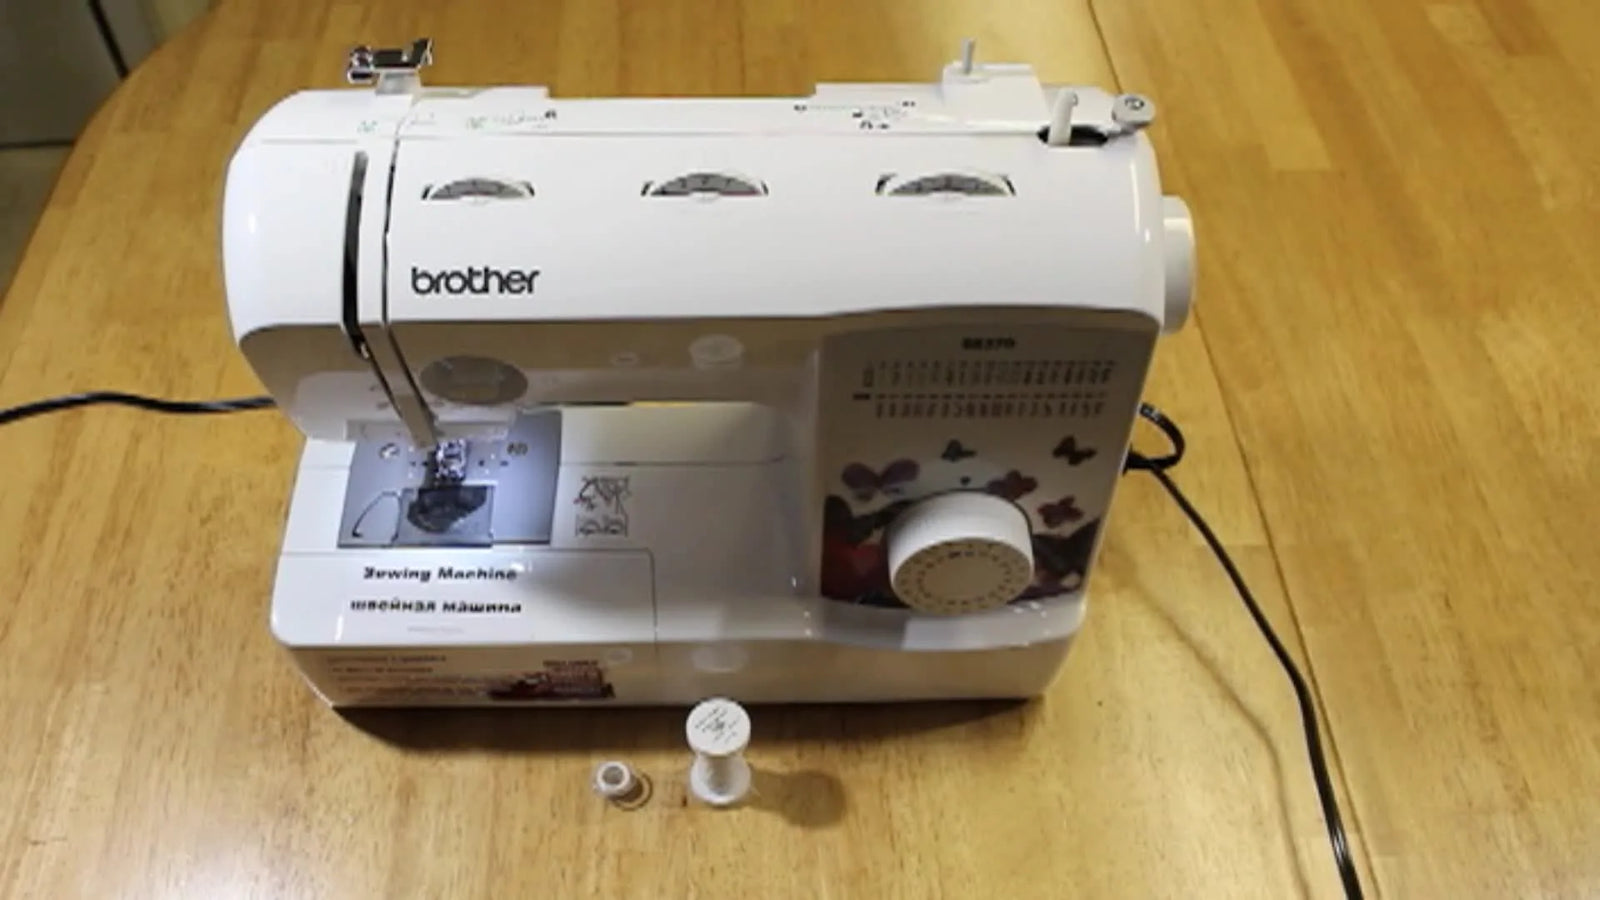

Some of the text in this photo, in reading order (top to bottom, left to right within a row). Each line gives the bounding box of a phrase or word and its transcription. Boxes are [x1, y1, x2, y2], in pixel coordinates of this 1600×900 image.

[411, 265, 540, 295] brother
[363, 566, 518, 583] Sewing Machine
